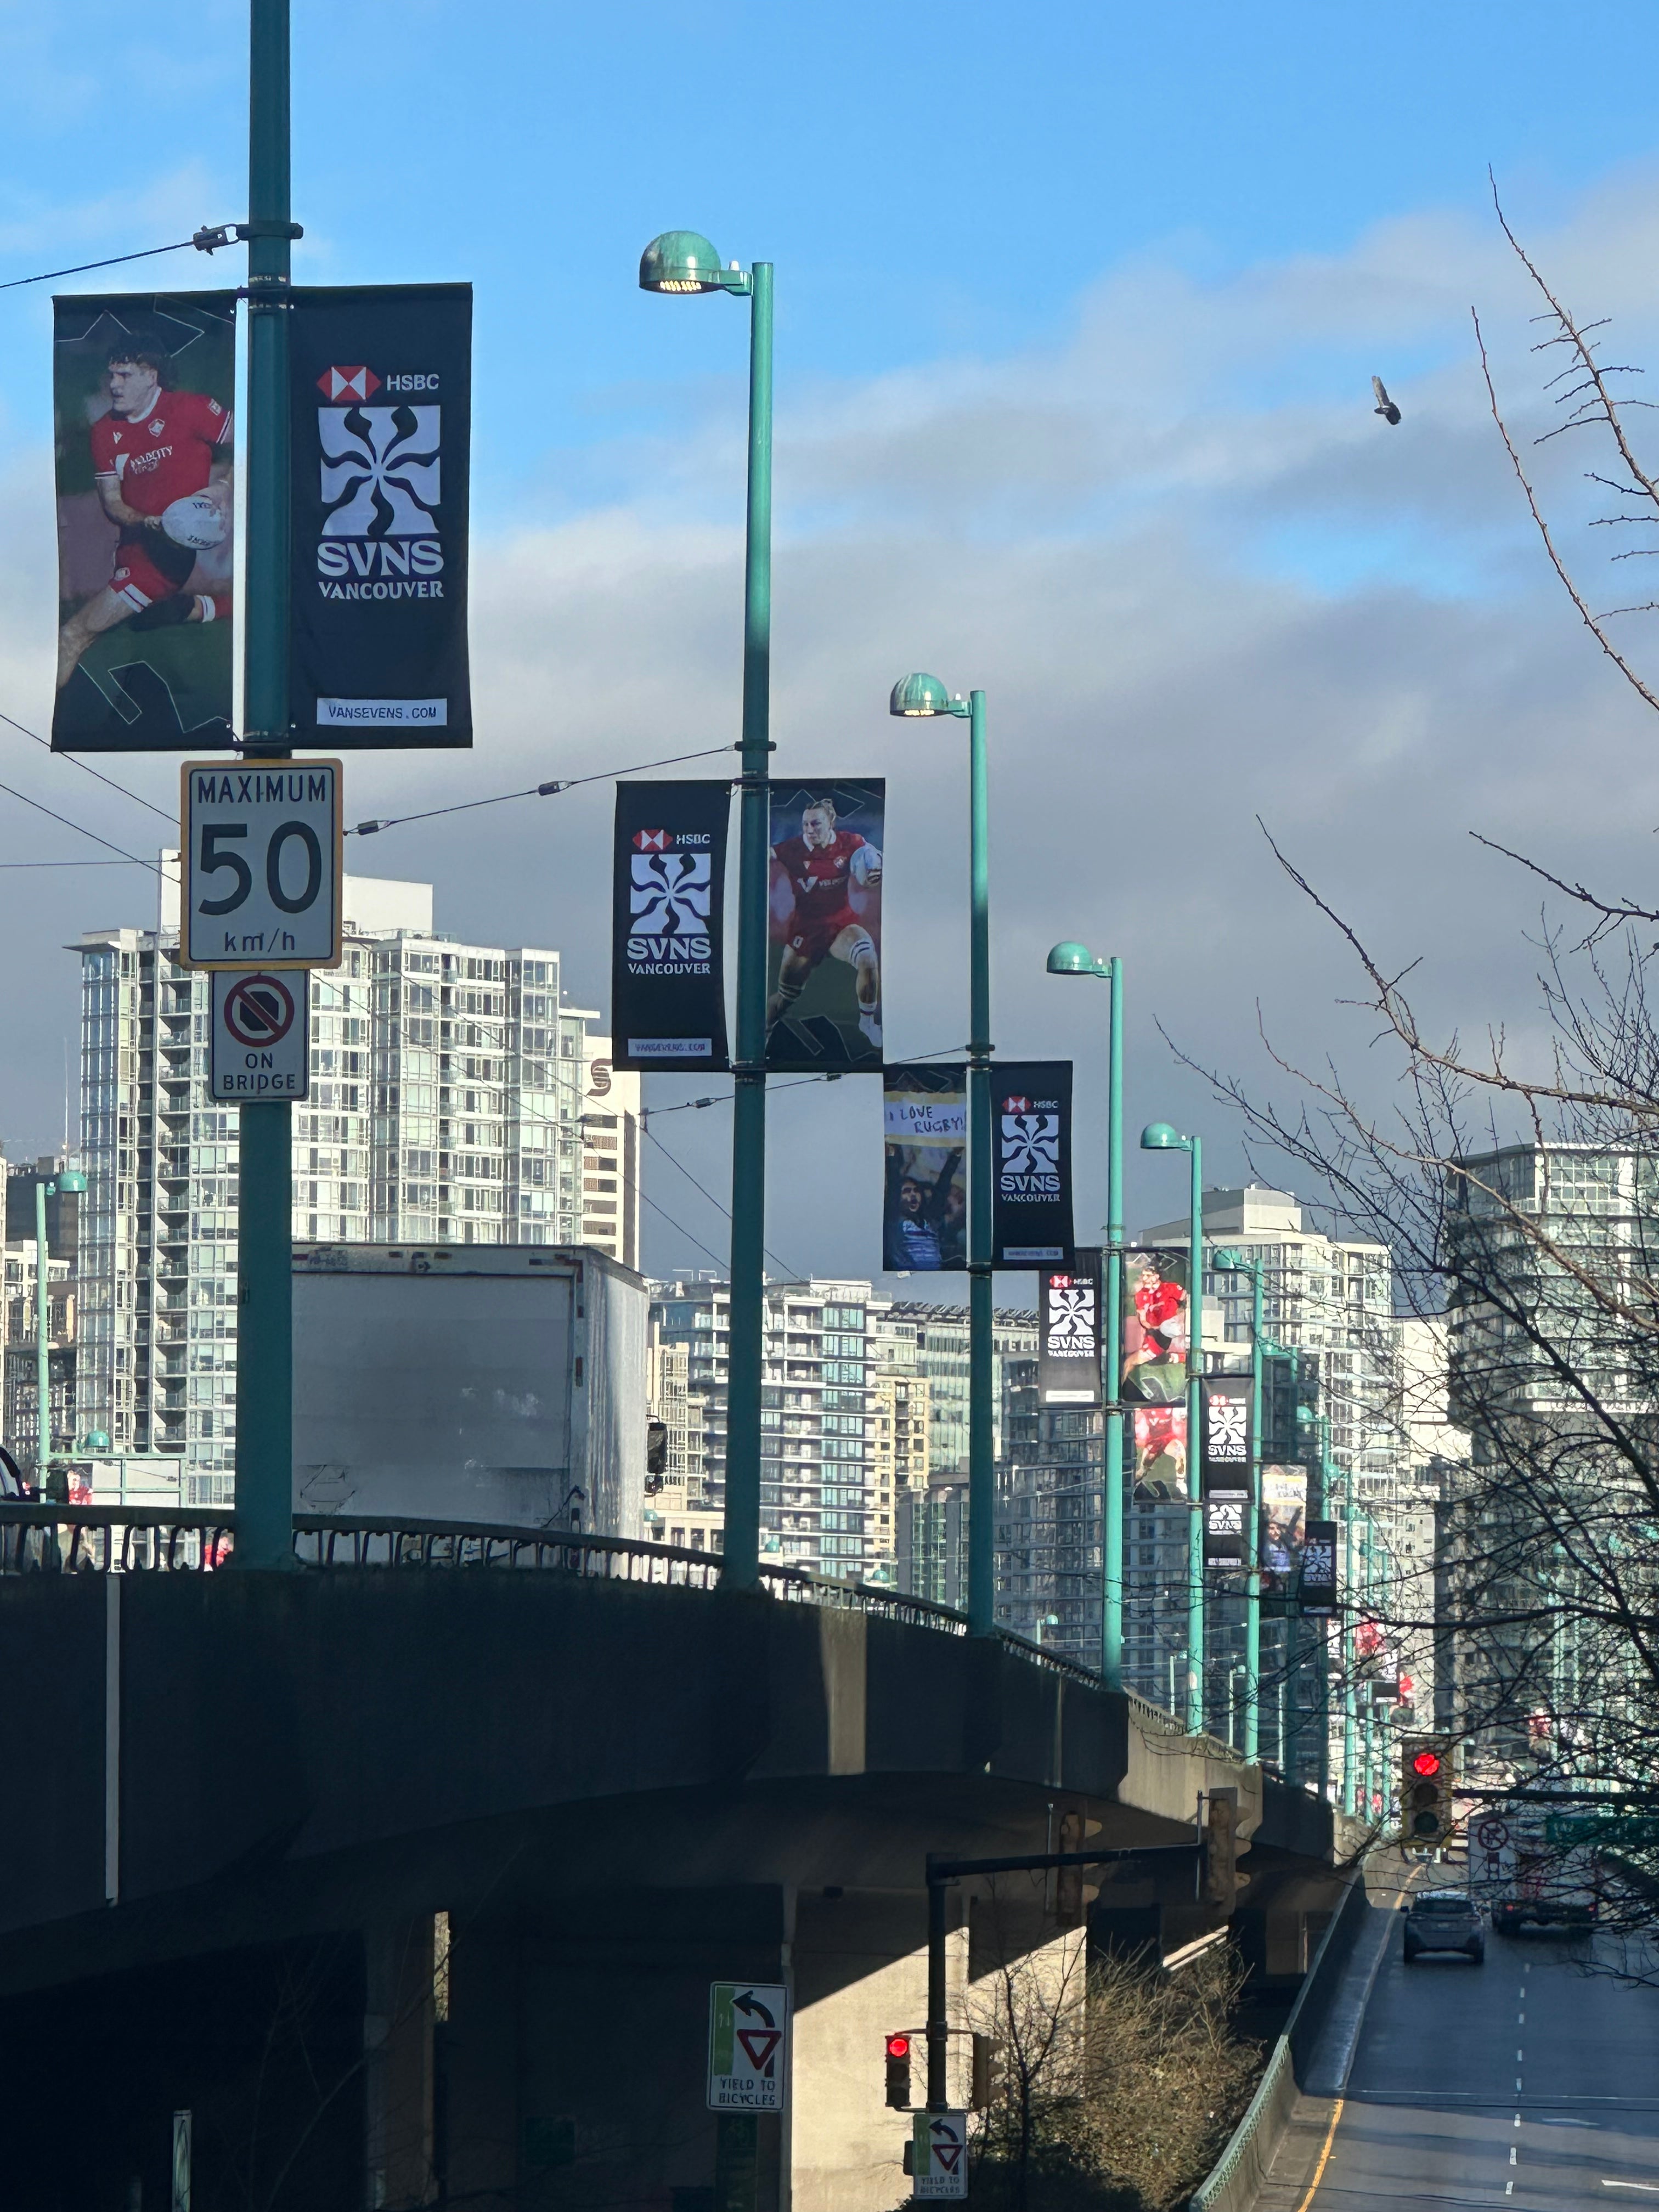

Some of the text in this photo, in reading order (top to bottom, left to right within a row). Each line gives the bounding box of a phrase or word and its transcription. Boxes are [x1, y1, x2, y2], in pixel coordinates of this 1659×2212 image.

[387, 374, 439, 391] HSBC
[317, 540, 444, 576] SVNS
[318, 580, 444, 600] VANCOUVER
[329, 706, 437, 719] VANSEVENS.COM
[198, 775, 325, 803] MAXIMUM
[676, 834, 710, 845] HSBC
[198, 821, 322, 916] 50
[224, 928, 295, 953] km/h
[627, 937, 712, 960] SVNS
[628, 963, 711, 975] VANCOUVER
[245, 1053, 273, 1069] ON
[223, 1074, 296, 1091] BRIDGE
[900, 1105, 933, 1120] LOVE
[1034, 1101, 1059, 1109] HSBC
[1001, 1175, 1060, 1192] SVNS
[1047, 1336, 1096, 1350] SVNS
[720, 2077, 775, 2092] YIELD TO
[719, 2092, 775, 2106] BICYCLES
[949, 2176, 960, 2184] TO
